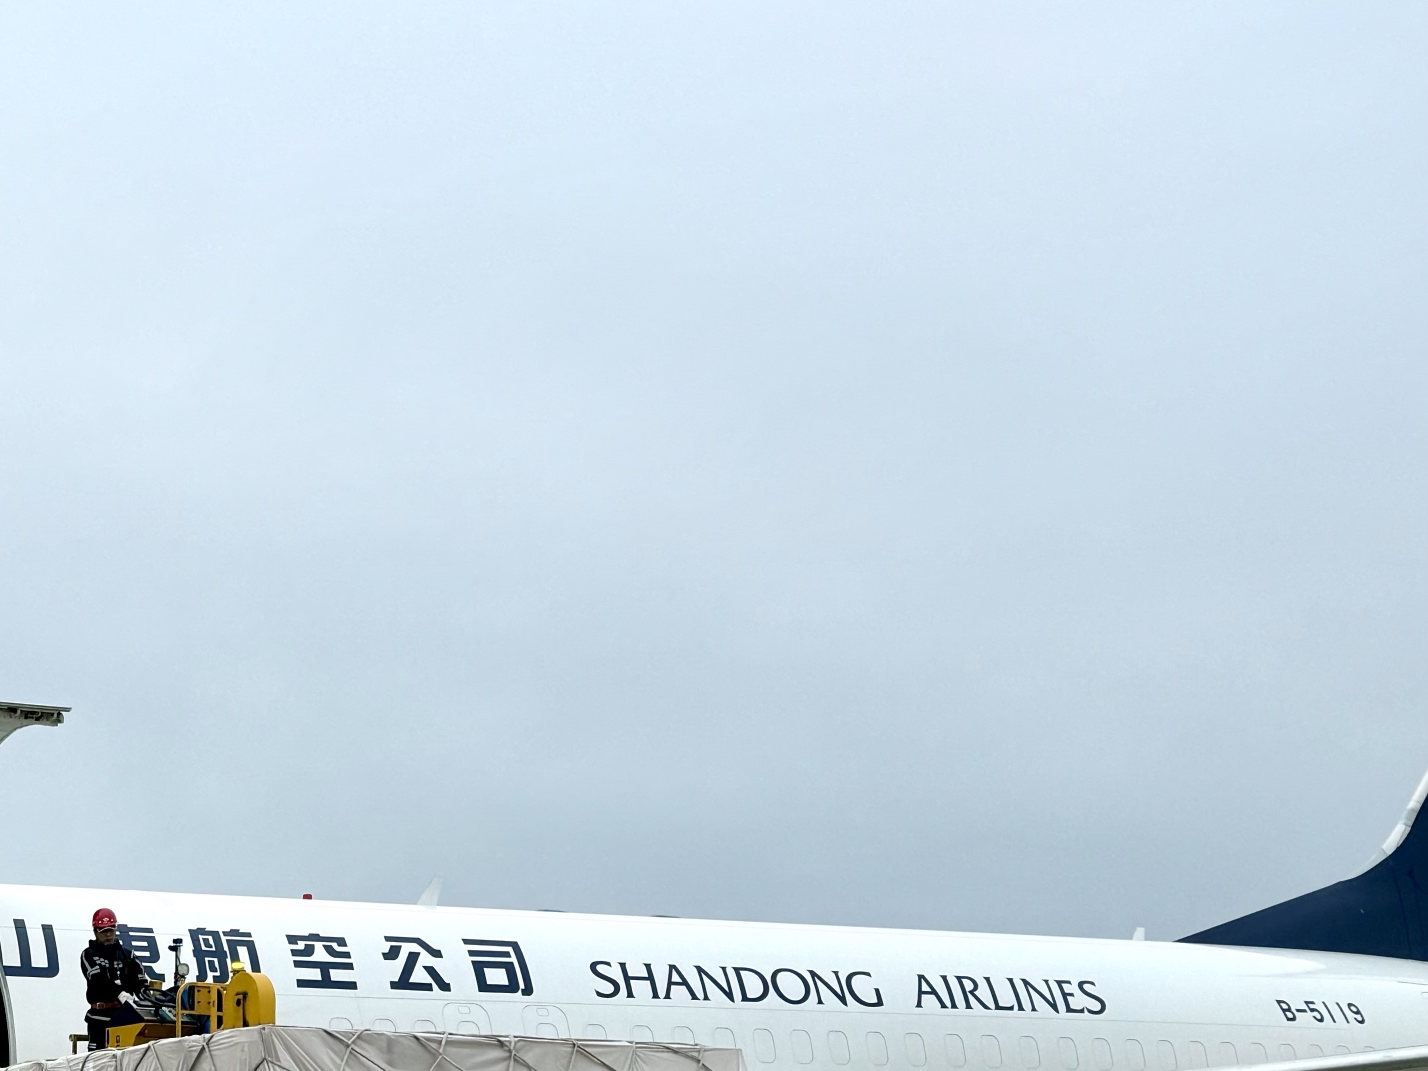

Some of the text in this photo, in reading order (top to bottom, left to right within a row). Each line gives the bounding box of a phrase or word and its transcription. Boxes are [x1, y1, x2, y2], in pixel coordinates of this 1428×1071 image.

[589, 960, 1107, 1016] SHANDONG AIRLINES
[1275, 999, 1366, 1025] B-5119
